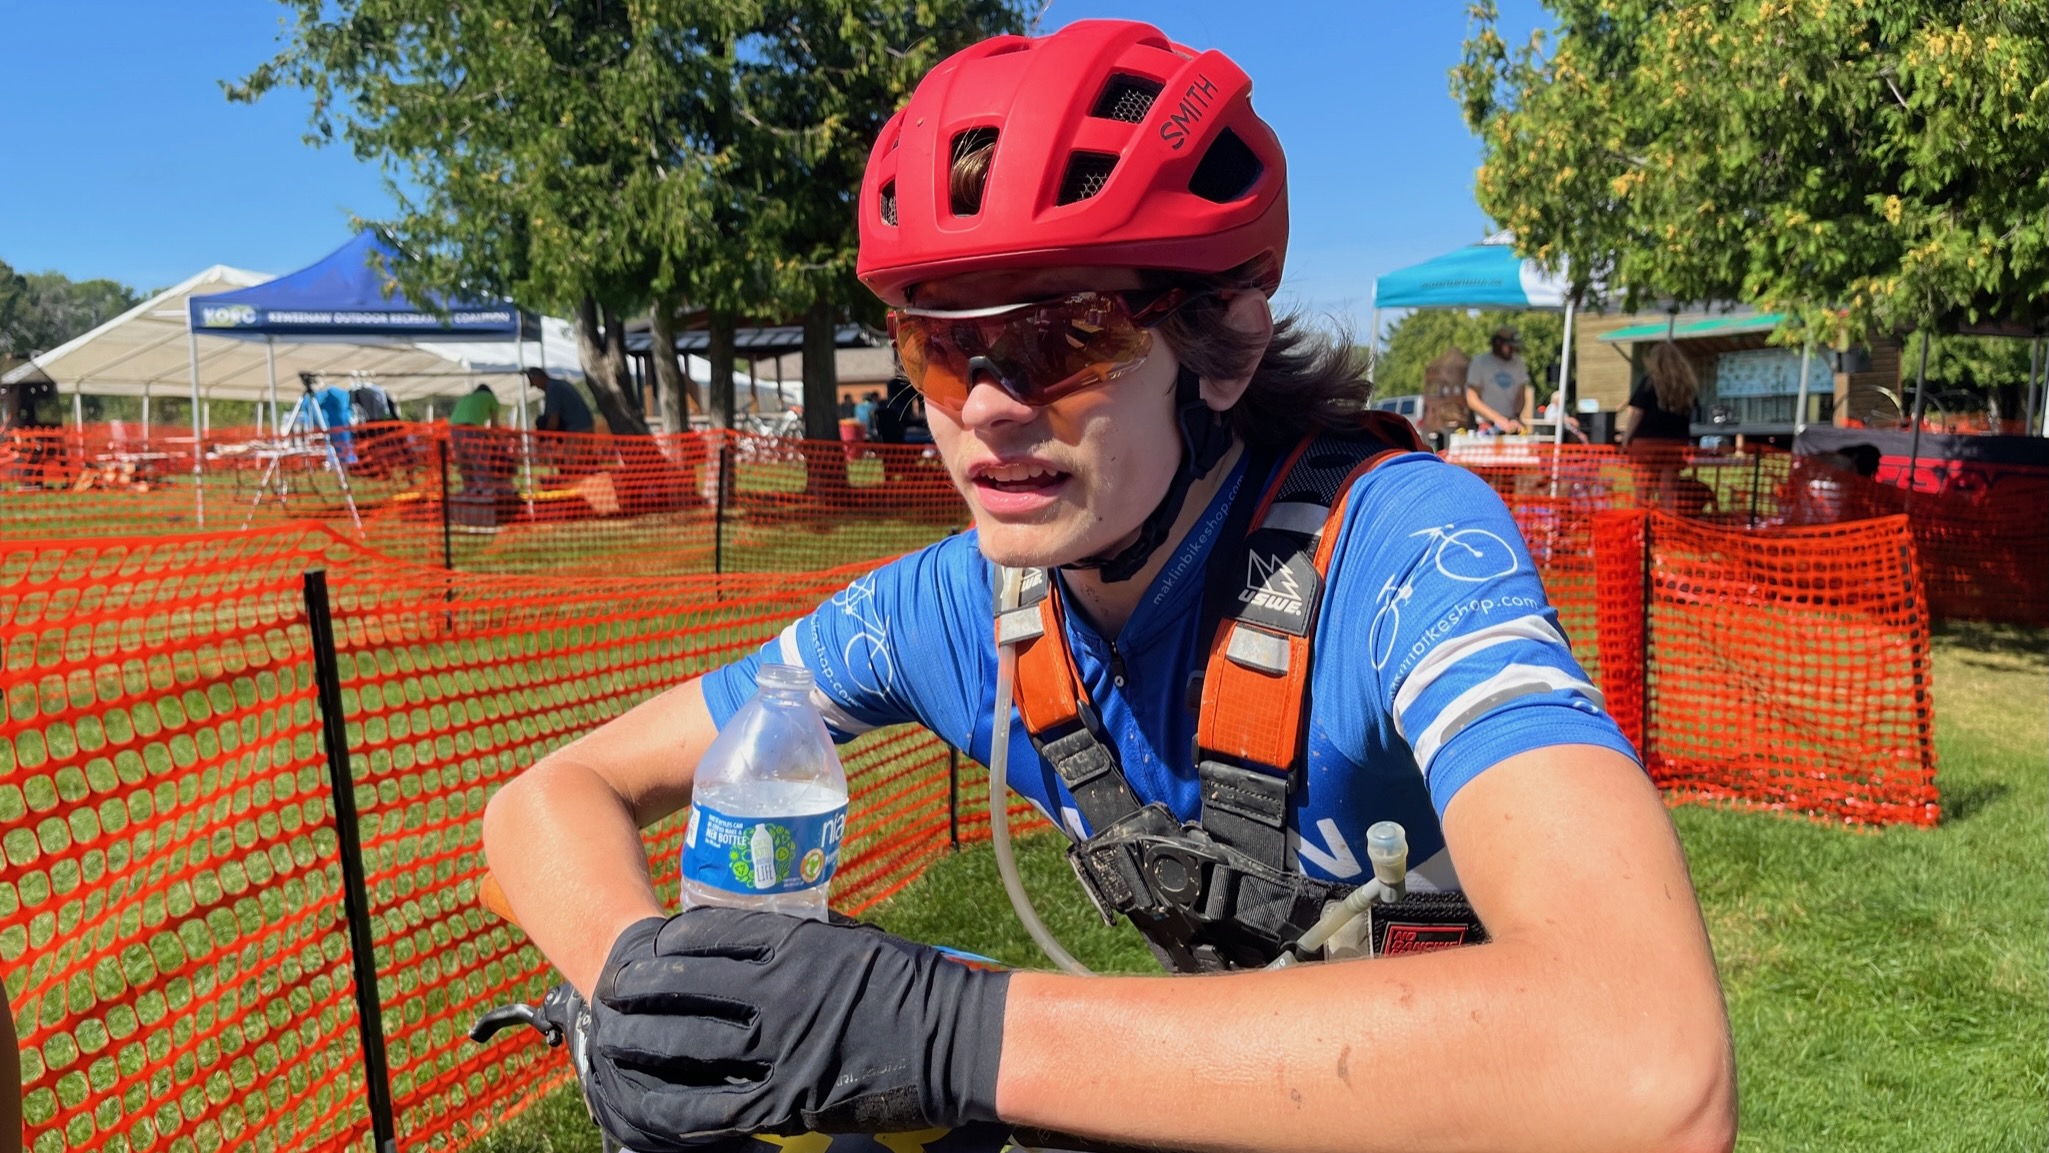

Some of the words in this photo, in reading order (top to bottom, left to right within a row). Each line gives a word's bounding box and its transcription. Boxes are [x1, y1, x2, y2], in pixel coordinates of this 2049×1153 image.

[1160, 73, 1219, 150] SMITH
[333, 311, 388, 324] OUTDOOR
[1153, 474, 1245, 606] maklinbikeshop.com
[718, 832, 748, 846] BOTTLE
[756, 863, 774, 882] LIFE
[1393, 931, 1417, 941] NO
